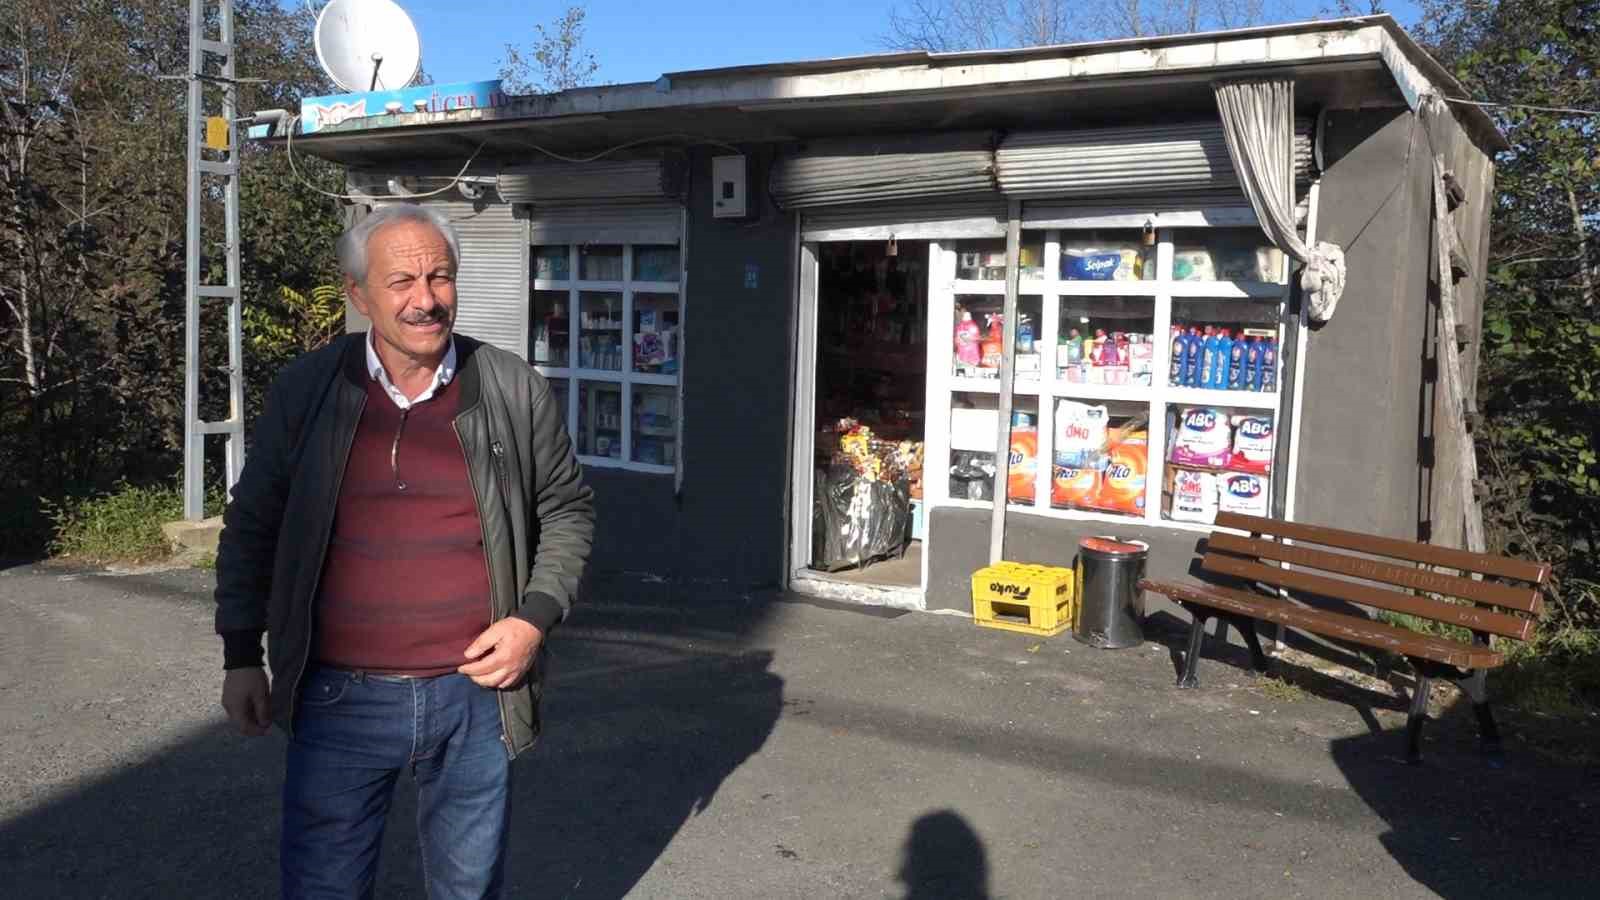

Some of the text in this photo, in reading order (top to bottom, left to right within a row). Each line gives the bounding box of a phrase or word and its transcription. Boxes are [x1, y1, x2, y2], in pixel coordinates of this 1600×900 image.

[1187, 413, 1214, 427] ABC
[1242, 420, 1271, 435] ABC
[1230, 479, 1260, 493] ABC
